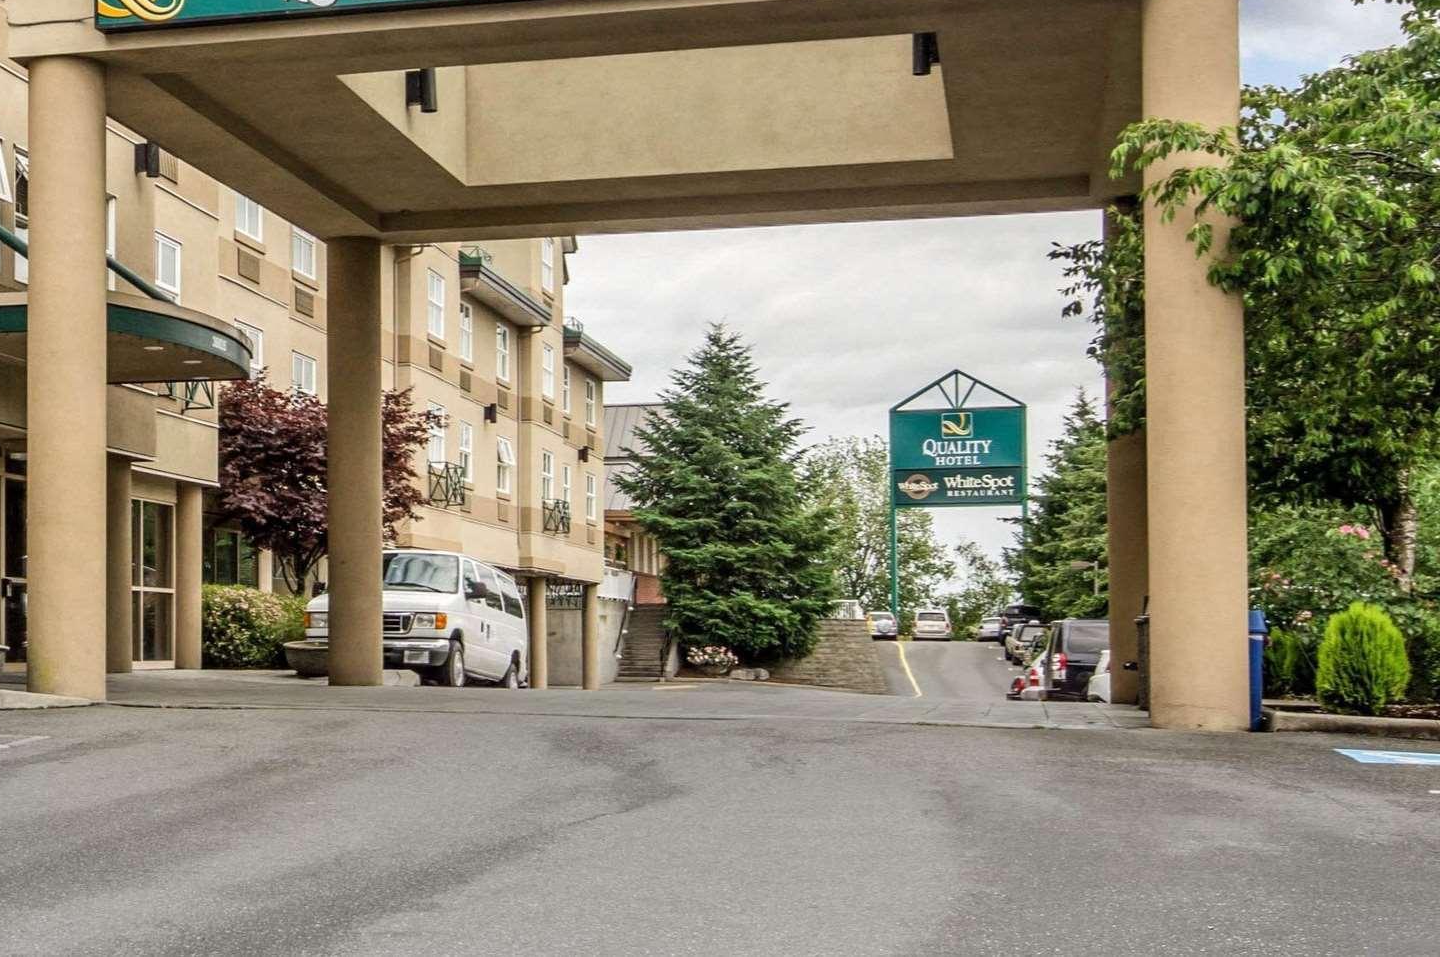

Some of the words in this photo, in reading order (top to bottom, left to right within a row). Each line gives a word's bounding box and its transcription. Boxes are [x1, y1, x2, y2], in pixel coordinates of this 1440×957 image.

[922, 438, 992, 456] QUALITY
[935, 455, 982, 465] HOTEL
[946, 488, 1016, 497] RESTAURANT
